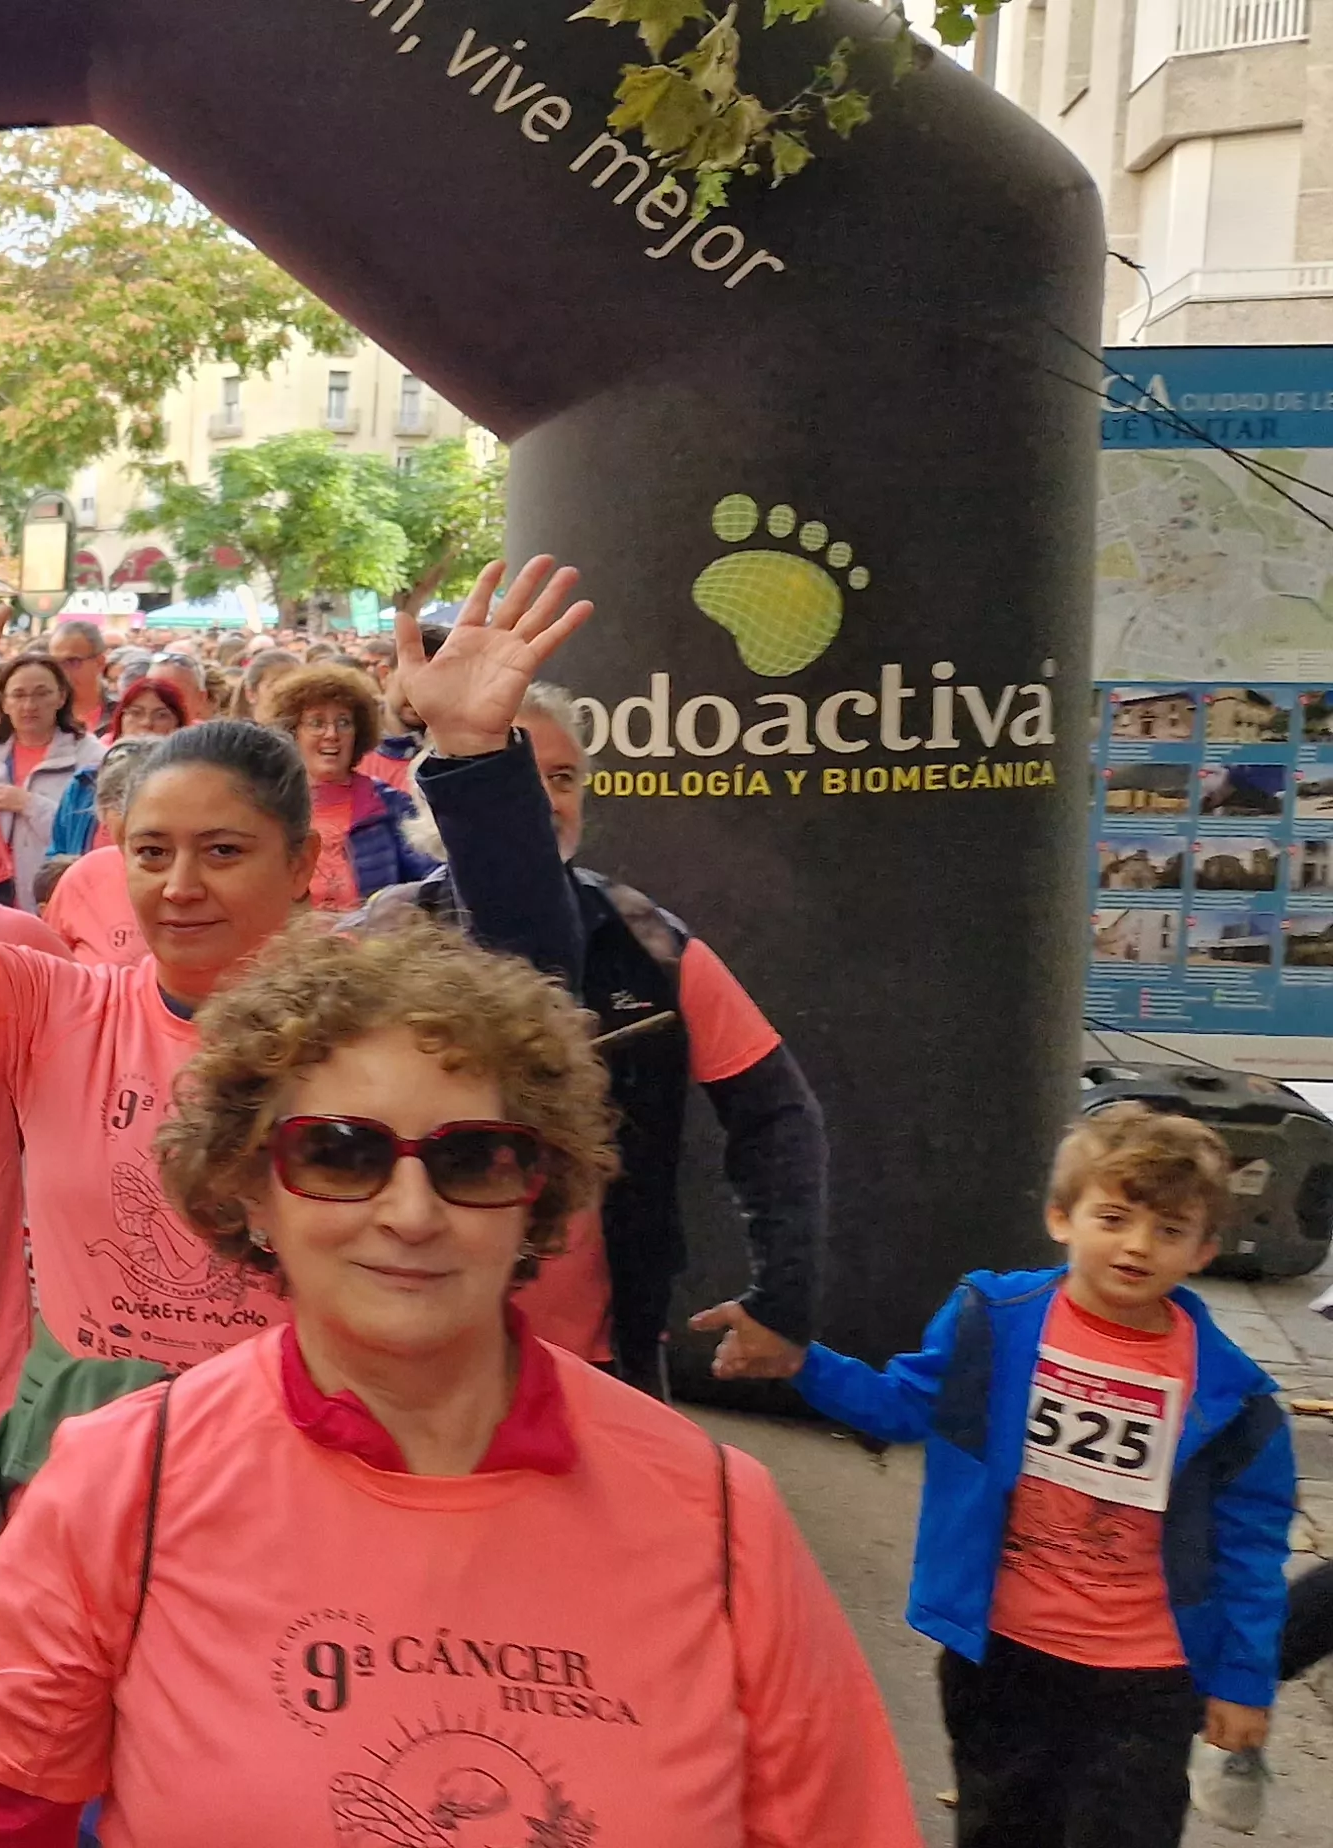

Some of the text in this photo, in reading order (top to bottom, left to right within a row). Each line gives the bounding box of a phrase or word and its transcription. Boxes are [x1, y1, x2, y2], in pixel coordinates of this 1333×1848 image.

[446, 28, 788, 289] vive mejor
[569, 660, 1057, 759] odoactiva
[785, 769, 809, 796] Y
[822, 754, 1057, 795] BIOMECÁNICA
[111, 1089, 154, 1130] 9ª
[202, 1309, 268, 1328] MUCHO
[1026, 1397, 1154, 1471] 525
[301, 1628, 596, 1714] 9ª CÁNCER
[497, 1685, 643, 1727] HUESCA
